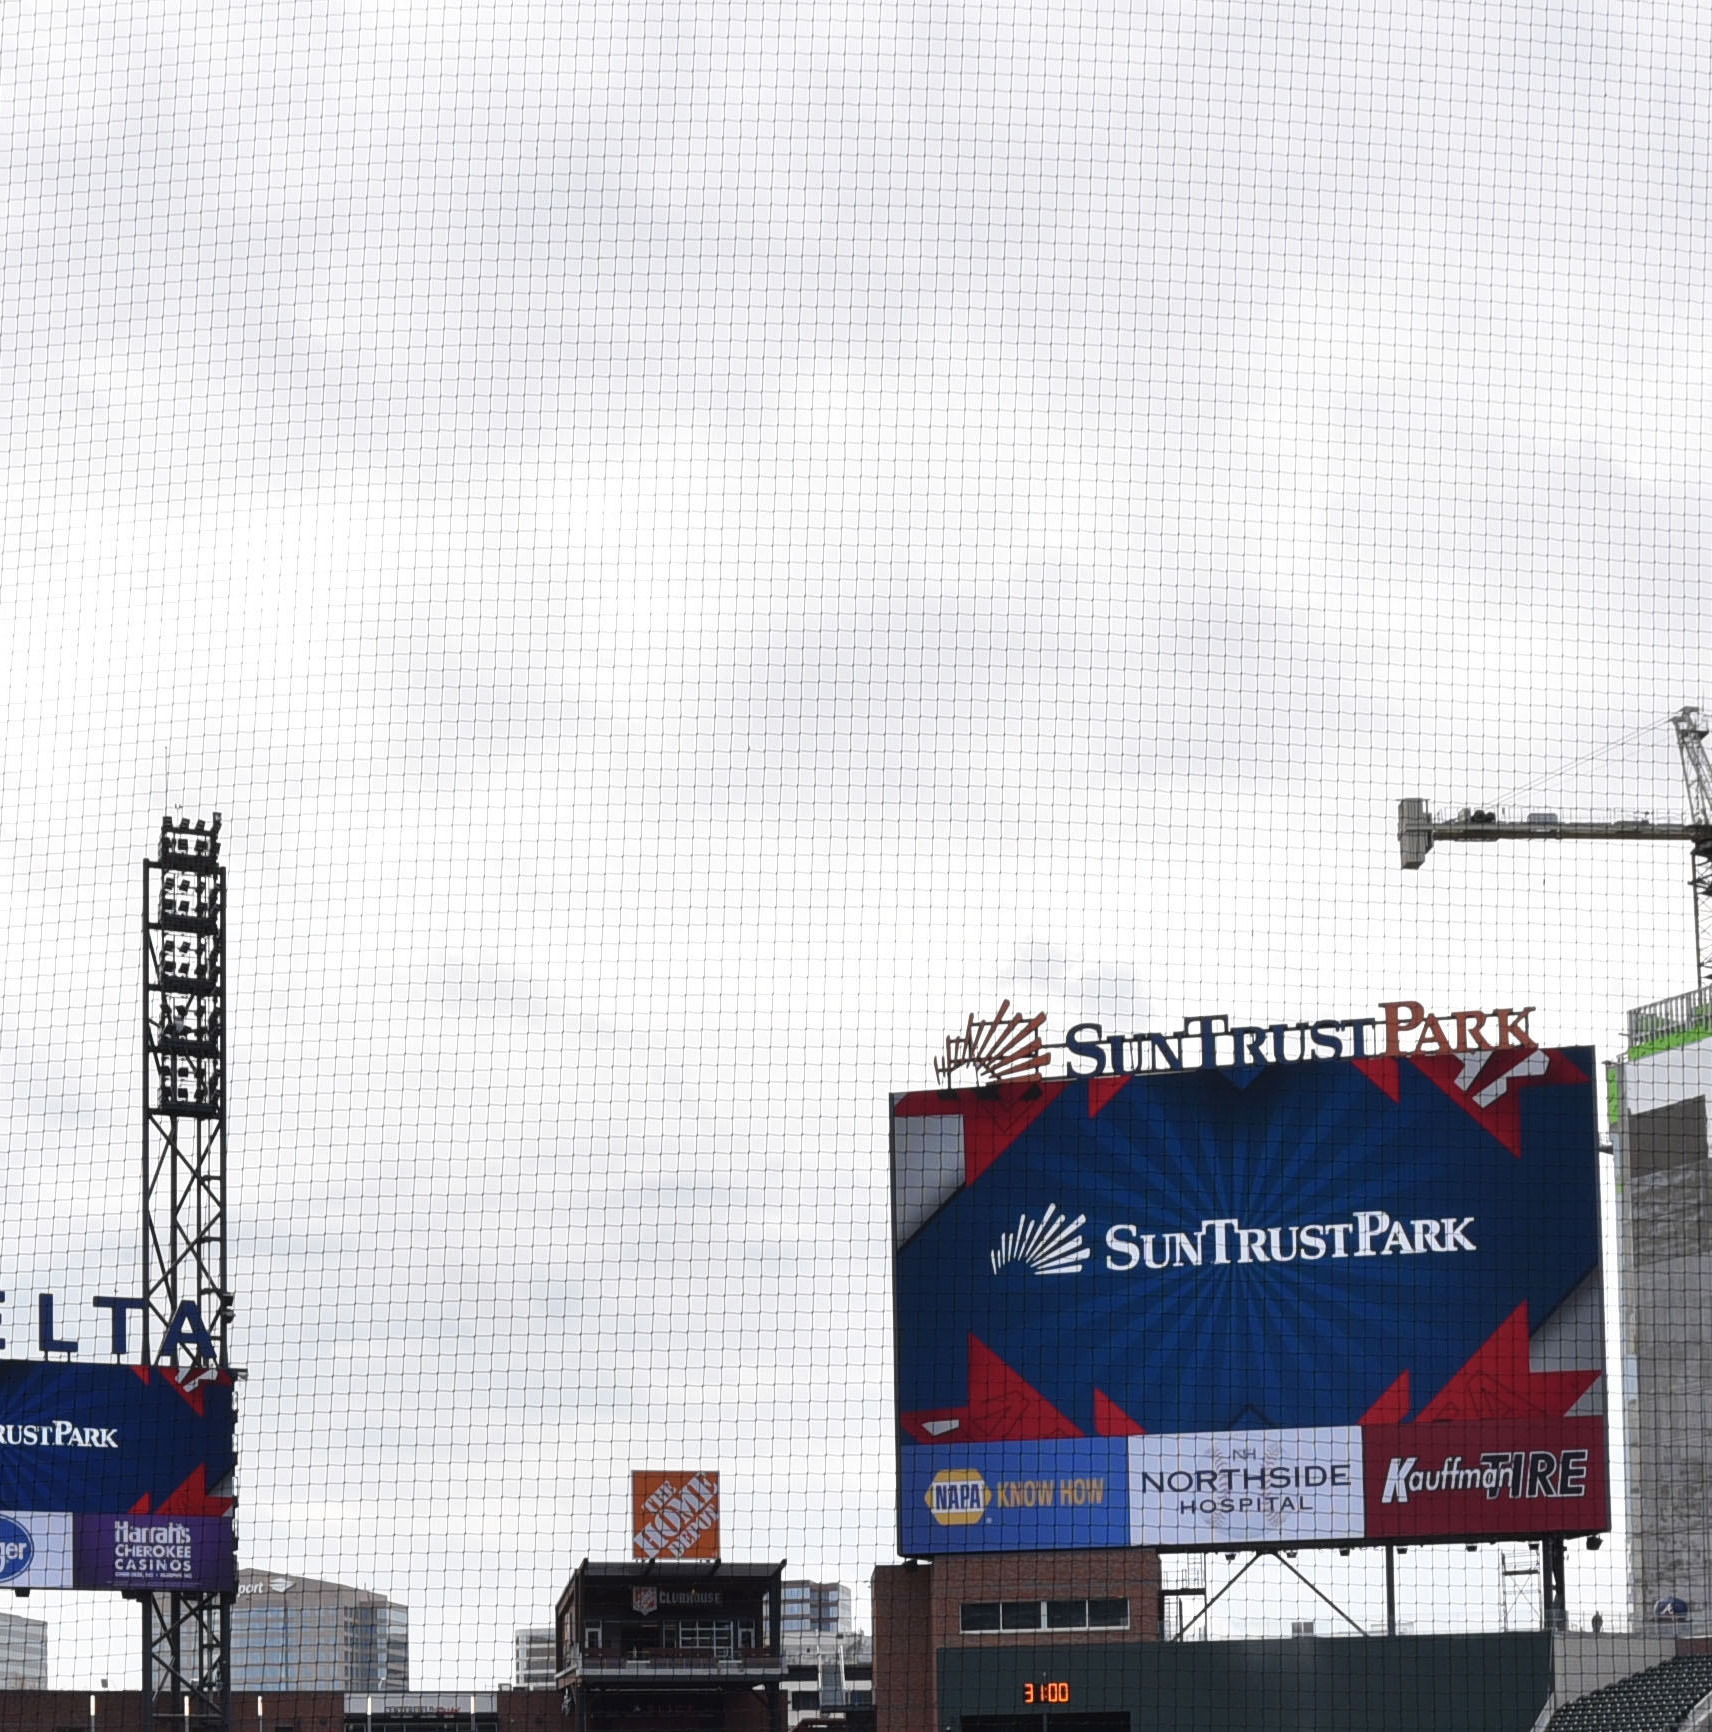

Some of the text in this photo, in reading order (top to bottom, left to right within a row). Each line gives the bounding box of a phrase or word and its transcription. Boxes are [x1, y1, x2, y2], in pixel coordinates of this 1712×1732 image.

[1142, 1465, 1352, 1494] NORTHSIDE
[1381, 1449, 1588, 1503] Kauffman TIRE
[641, 1480, 677, 1516] THE
[936, 1485, 981, 1510] NAPA
[997, 1478, 1105, 1508] KNOW HOW
[1180, 1495, 1313, 1516] HOSPITAL
[633, 1471, 718, 1558] HOME
[666, 1503, 719, 1557] DEPOT
[114, 1544, 192, 1559] CHEROKEE
[114, 1559, 192, 1572] CASINOS
[658, 1591, 722, 1604] CLUBHOUSE
[1024, 1682, 1069, 1703] 31:00
